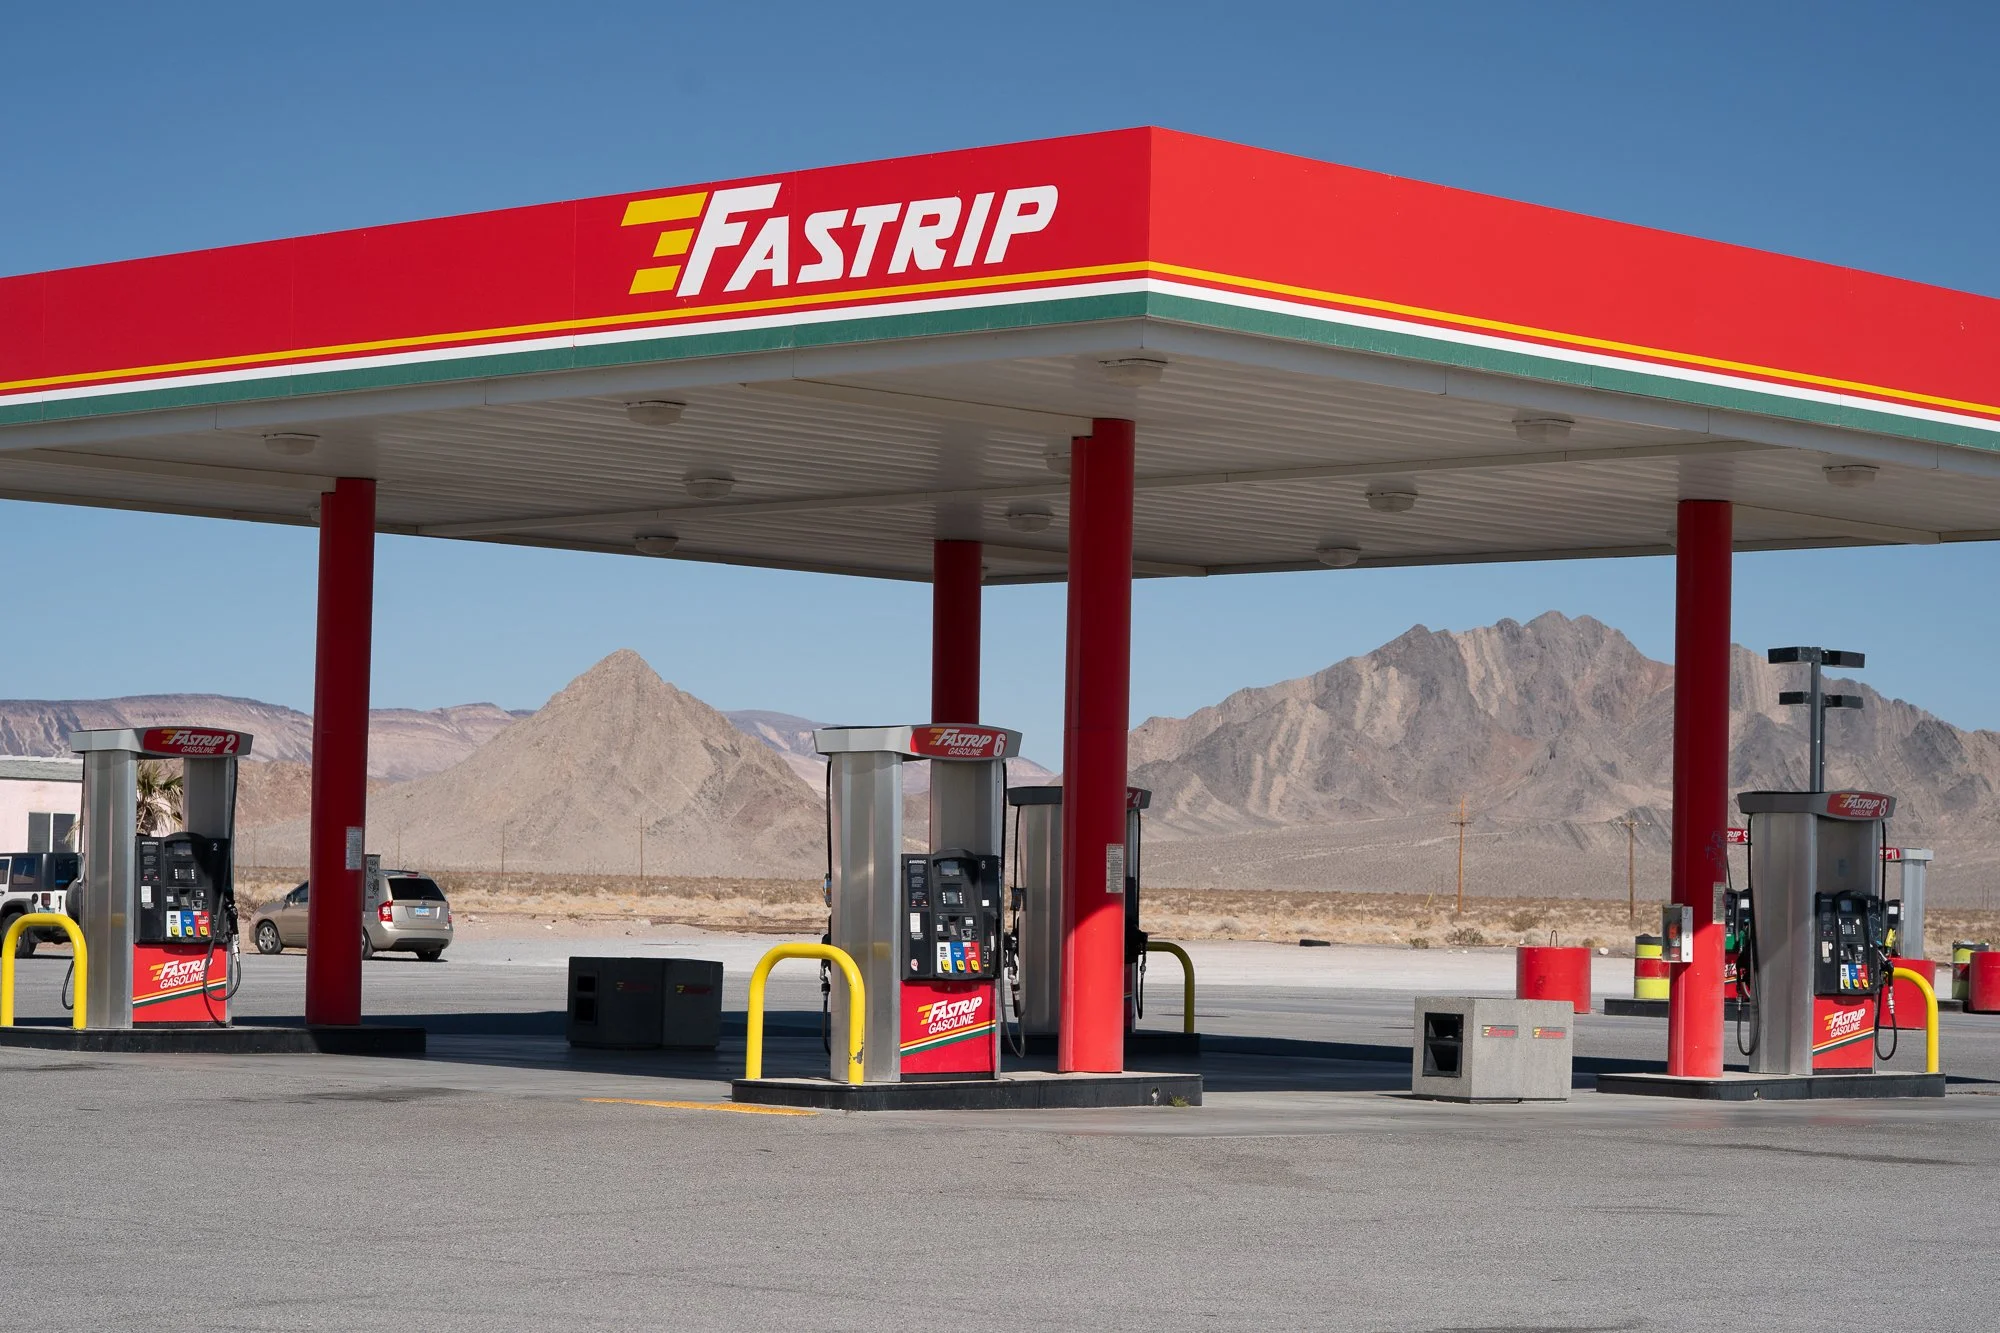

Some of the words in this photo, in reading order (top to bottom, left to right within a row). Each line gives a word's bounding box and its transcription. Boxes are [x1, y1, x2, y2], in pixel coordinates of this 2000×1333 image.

[676, 182, 1059, 298] FASTRIP
[167, 730, 225, 746] FASTRIP
[223, 734, 236, 754] 2
[181, 745, 217, 754] GASOLINE
[938, 728, 993, 748] FASTRIP
[993, 733, 1006, 757] 6
[947, 747, 984, 756] GASOLINE
[1132, 791, 1142, 808] 4
[1843, 794, 1880, 810] FASTRIP
[1879, 798, 1887, 816] 8
[213, 842, 218, 851] 2
[981, 860, 986, 870] 6
[160, 971, 204, 989] GASOLINE
[928, 996, 983, 1023] FASTRIP
[1830, 1008, 1866, 1029] FASTRIP
[928, 1012, 975, 1034] GASOLINE
[1831, 1020, 1861, 1038] GASOLINE
